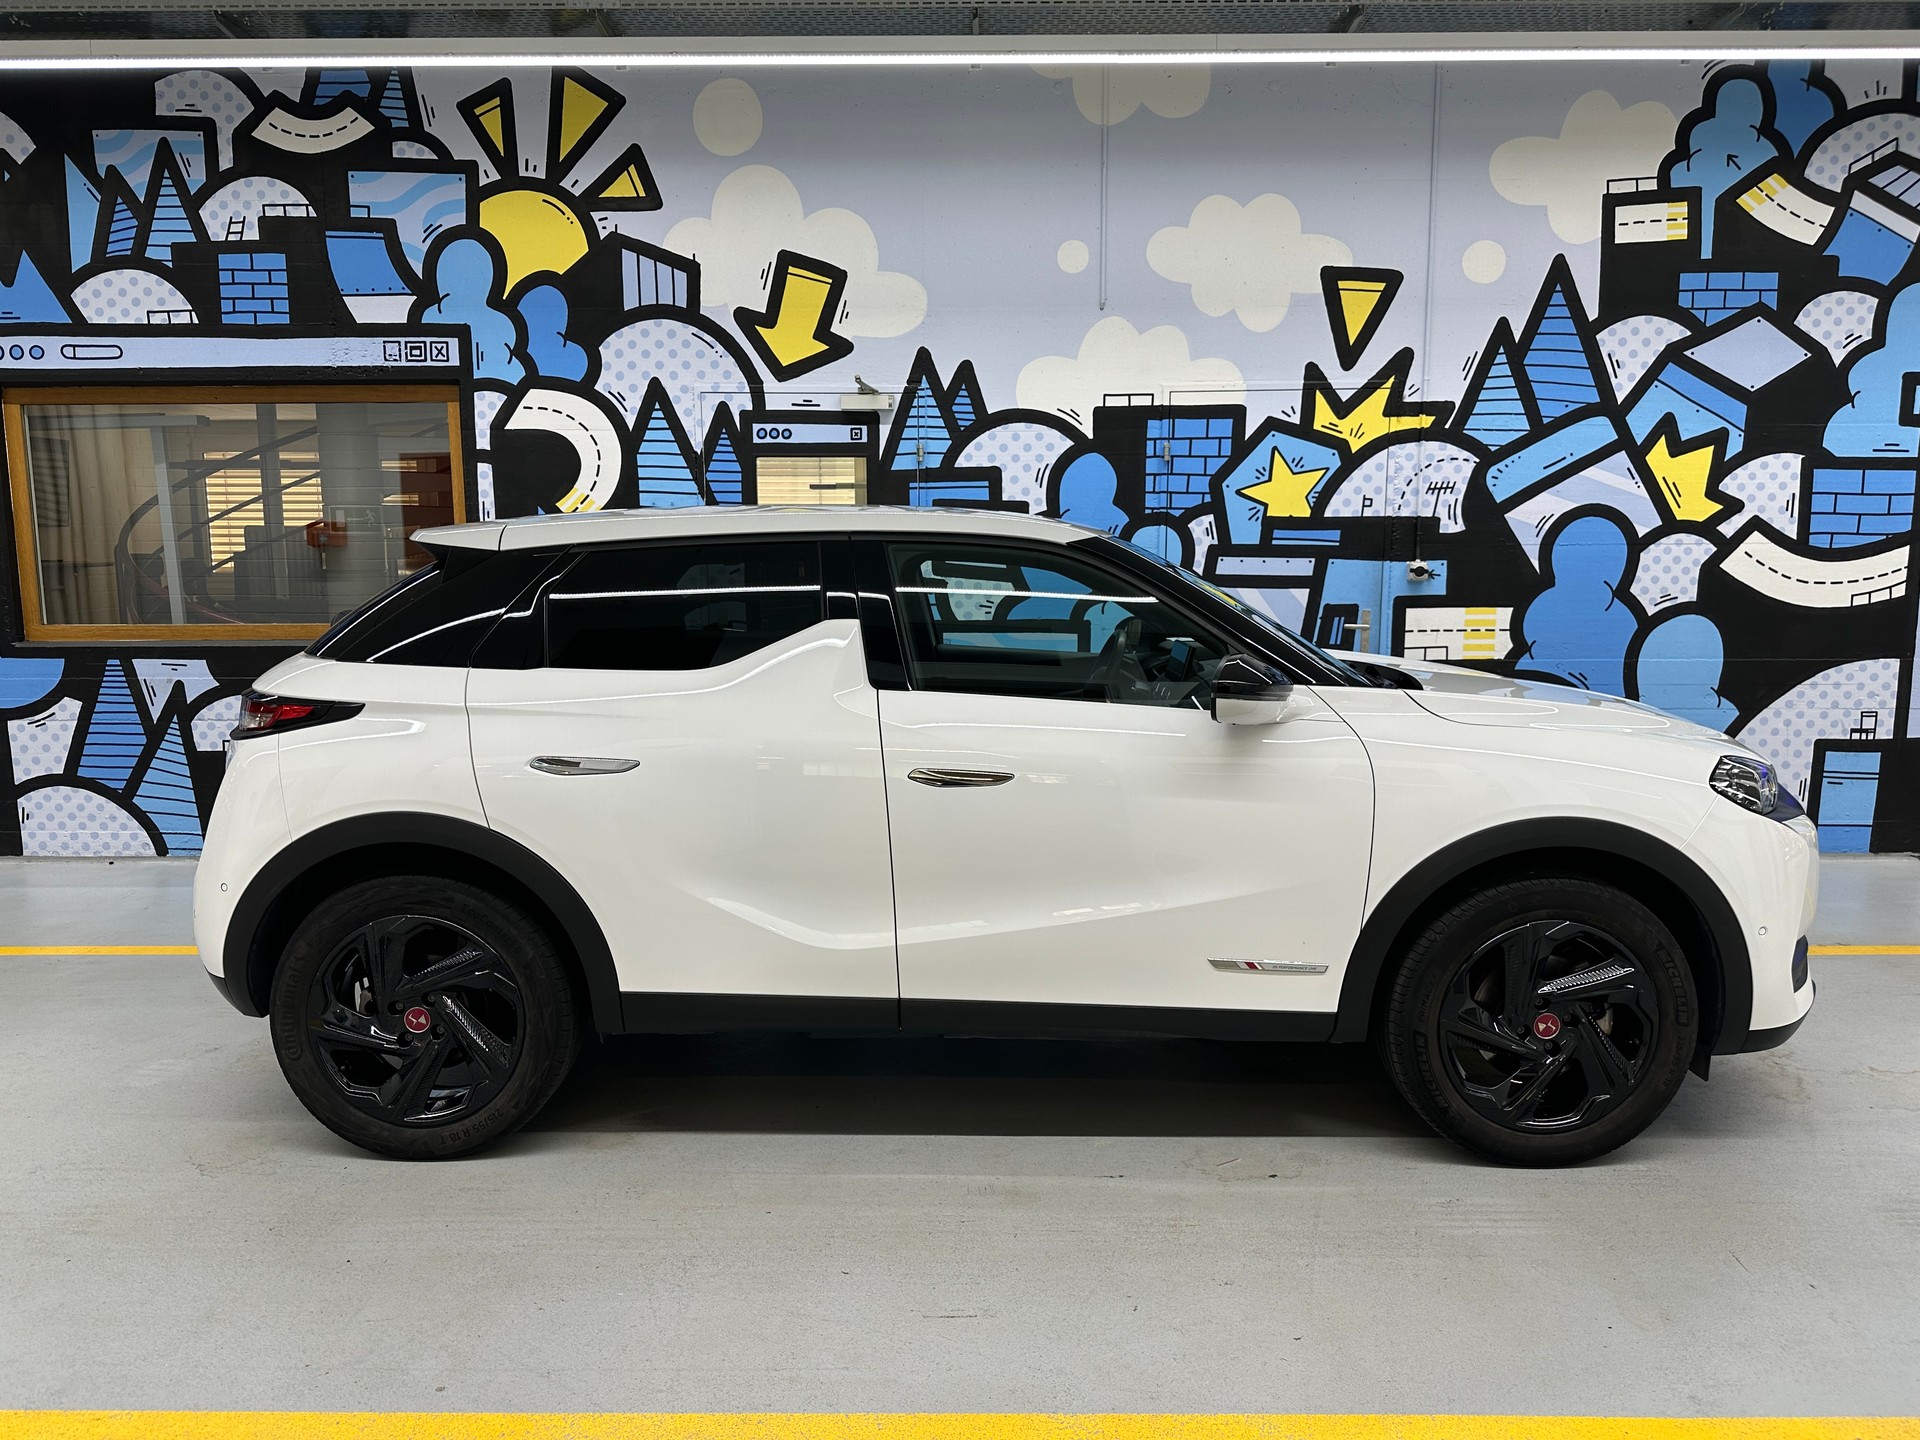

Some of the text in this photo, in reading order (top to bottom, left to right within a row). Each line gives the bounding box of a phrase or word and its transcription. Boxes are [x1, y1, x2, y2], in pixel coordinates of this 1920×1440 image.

[282, 965, 303, 1061] Continental
[1656, 949, 1689, 1027] MICHELIN
[1414, 1031, 1450, 1108] MICHELIN
[449, 1133, 462, 1143] 18
[463, 1130, 471, 1138] R
[472, 1108, 504, 1133] 215/55
